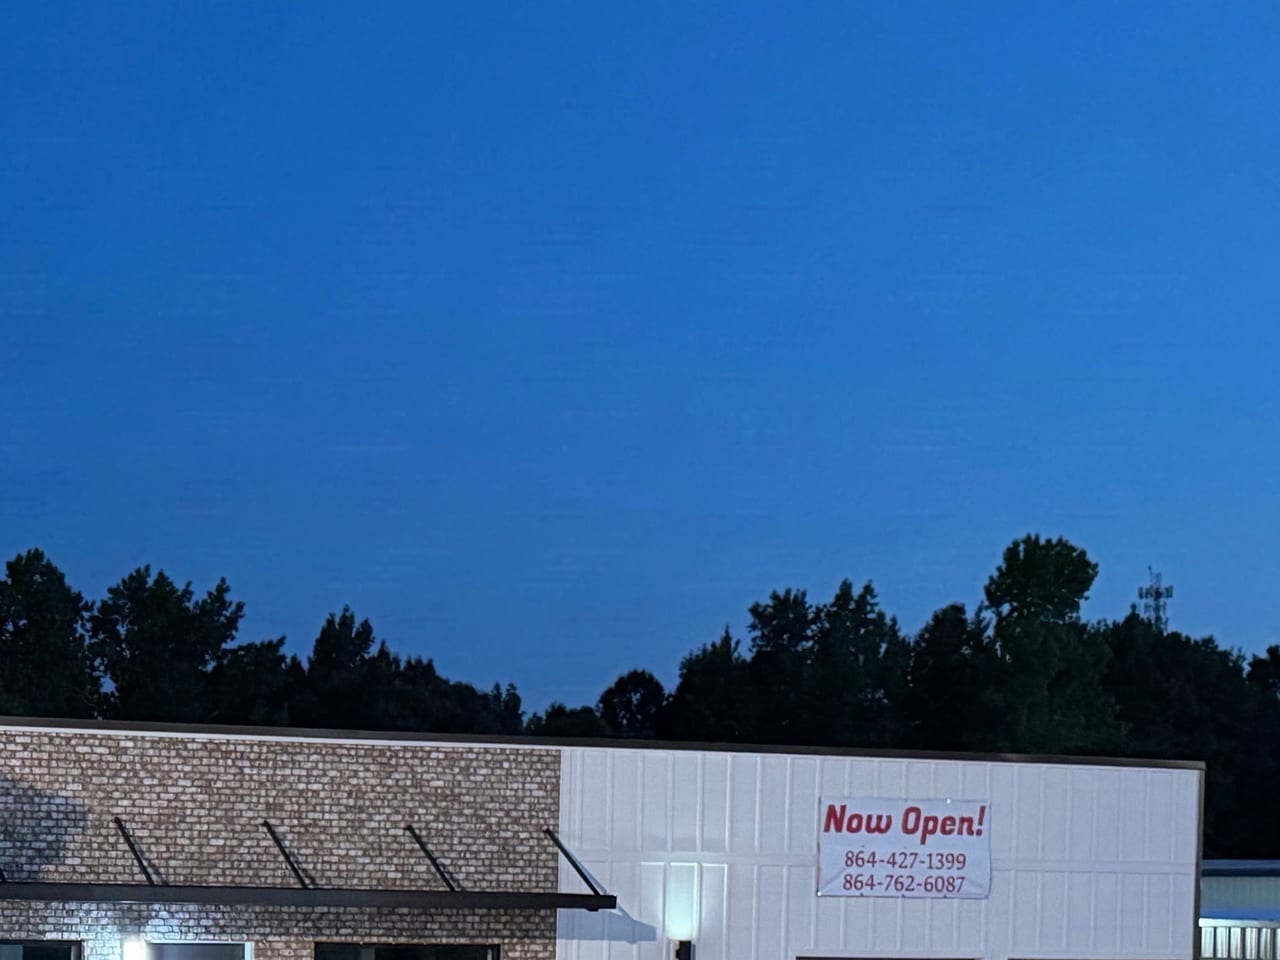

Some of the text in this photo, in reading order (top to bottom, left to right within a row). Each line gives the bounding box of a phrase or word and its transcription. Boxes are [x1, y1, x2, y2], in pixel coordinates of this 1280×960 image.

[823, 803, 987, 845] Now Open!
[844, 850, 967, 871] 864-427-1399
[842, 873, 966, 894] 864-762-6087
